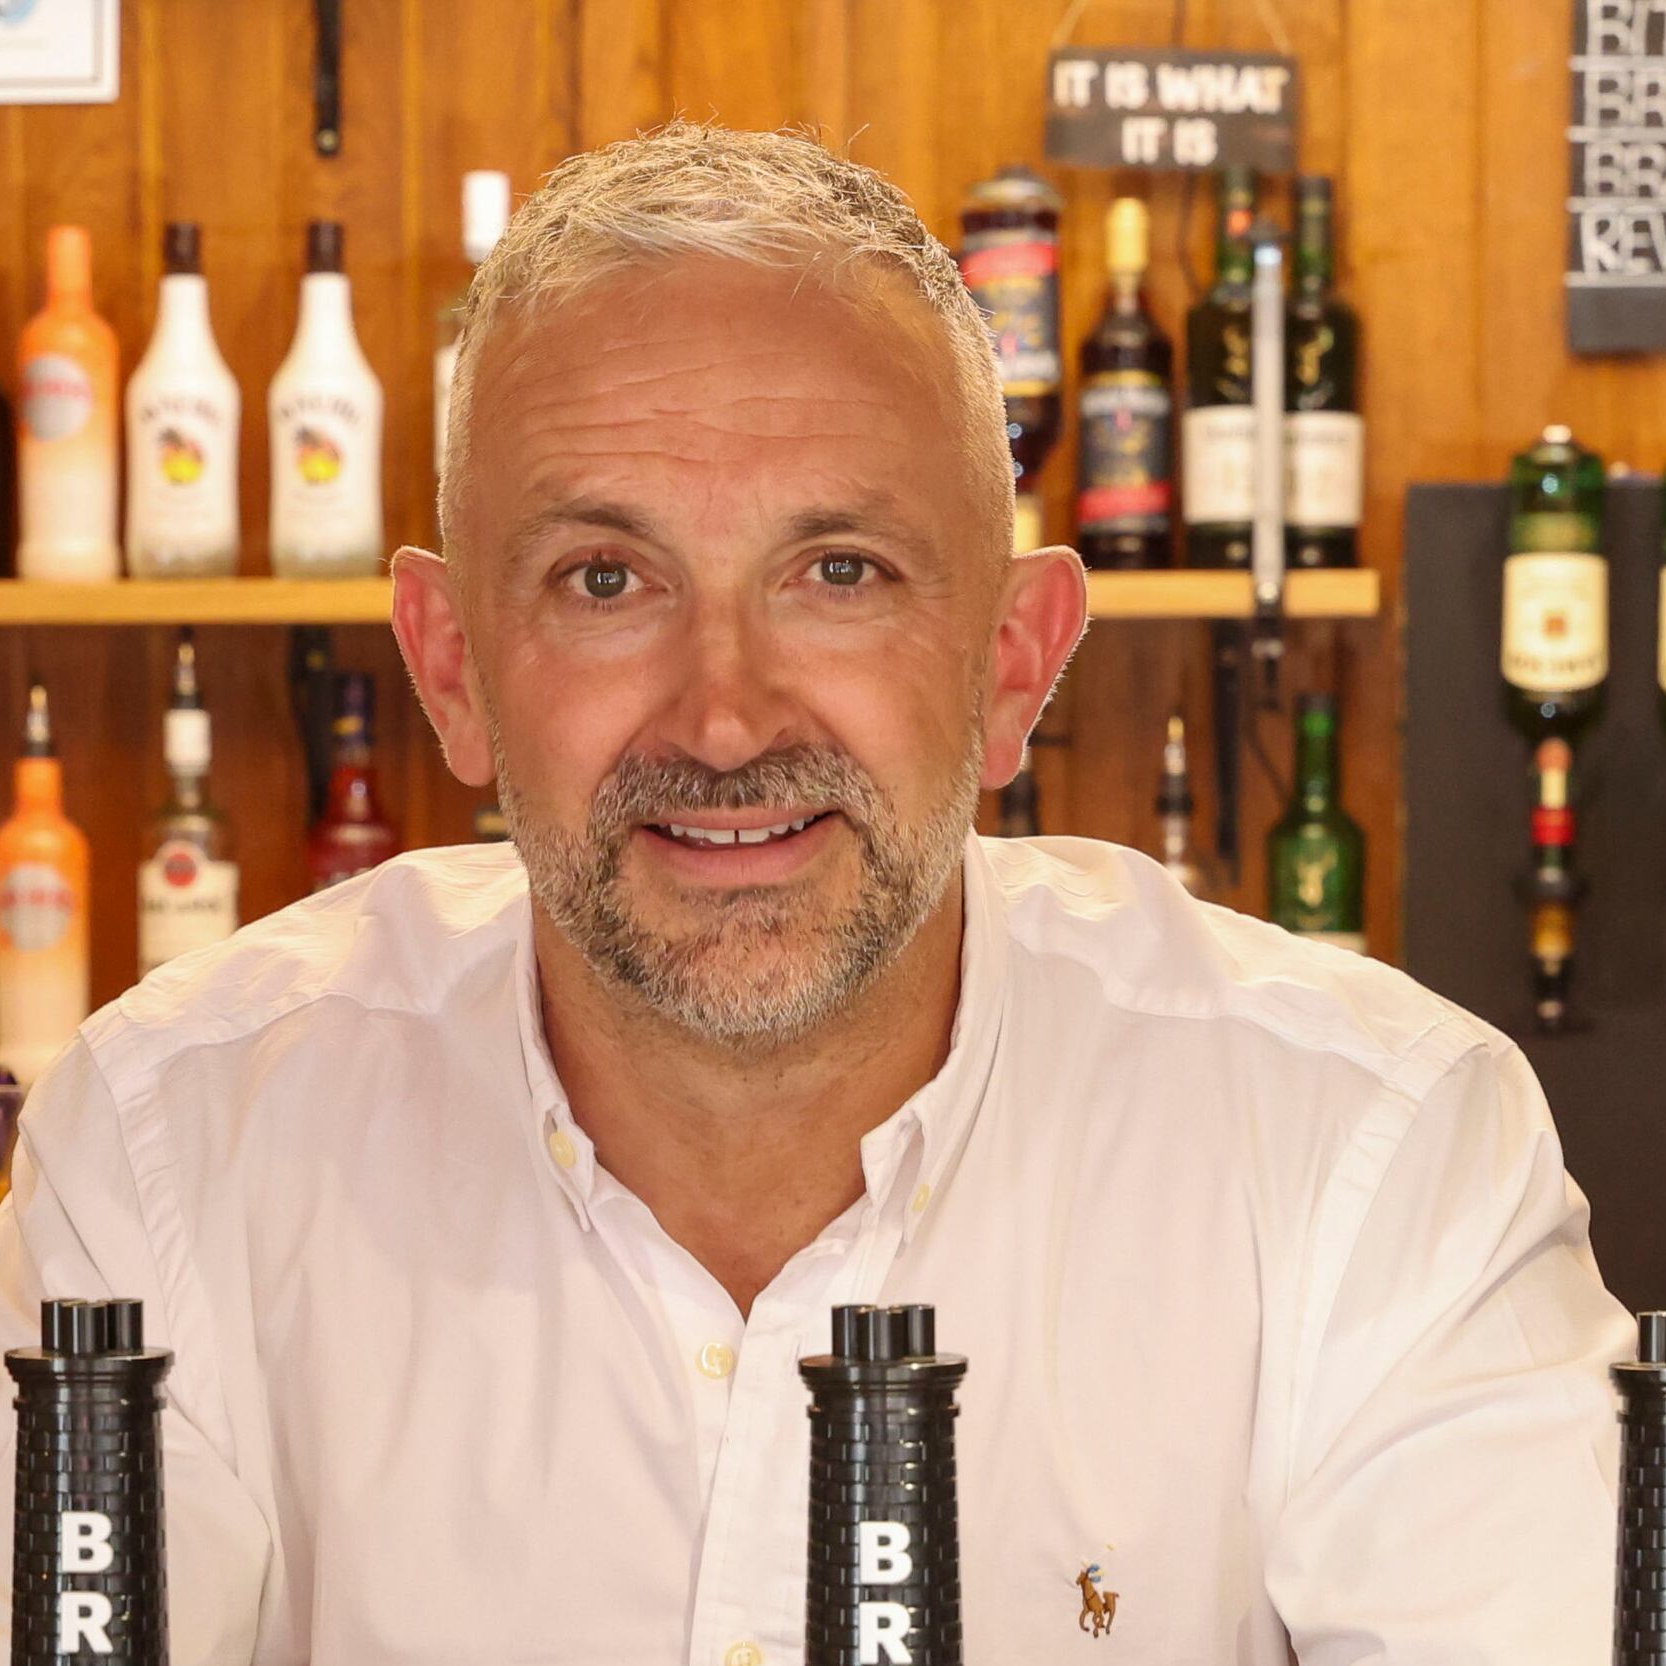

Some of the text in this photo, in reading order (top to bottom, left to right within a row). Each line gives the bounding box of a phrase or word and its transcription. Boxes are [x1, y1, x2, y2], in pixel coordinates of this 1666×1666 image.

[1052, 60, 1291, 114] IT IS WHAT
[1122, 117, 1218, 166] IT IS
